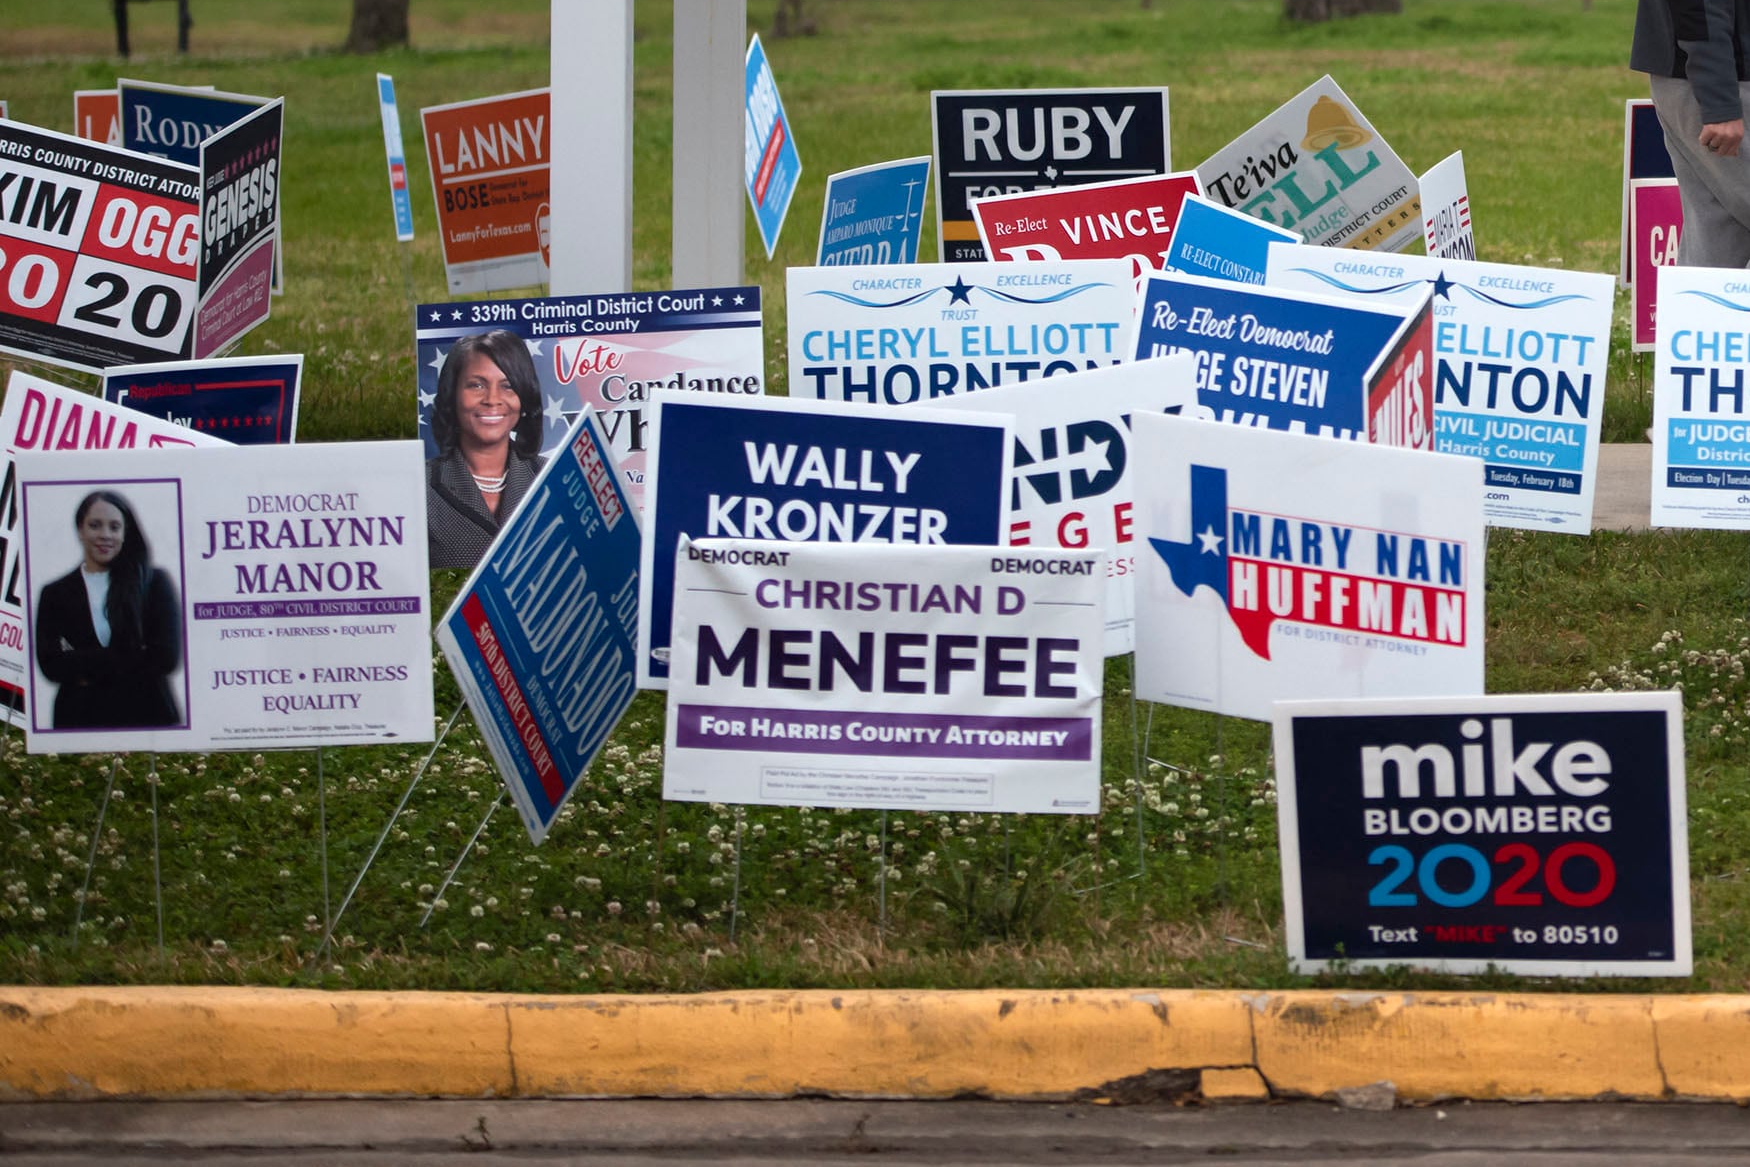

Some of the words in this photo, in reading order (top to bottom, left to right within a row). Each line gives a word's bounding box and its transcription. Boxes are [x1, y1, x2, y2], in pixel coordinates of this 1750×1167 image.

[434, 114, 544, 175] LANNY
[961, 105, 1136, 163] RUBY
[205, 158, 276, 247] GENESIS
[444, 183, 490, 214] BOSE
[1370, 185, 1410, 216] COURT
[98, 198, 200, 267] OGG
[450, 222, 531, 244] LannyForTexas.com
[995, 216, 1048, 237] Re-Elect
[1059, 206, 1171, 245] VINCE
[852, 277, 922, 292] CHARACTER
[996, 273, 1073, 287] EXCELLENCE
[1334, 261, 1405, 279] CHARACTER
[1478, 275, 1555, 294] EXCELLENCE
[74, 271, 182, 338] 20
[471, 302, 516, 324] 339th
[521, 298, 593, 321] Criminal
[596, 294, 653, 318] District
[657, 293, 705, 314] Court
[940, 308, 979, 322] TRUST
[532, 319, 578, 336] Harris
[580, 317, 641, 334] County
[802, 327, 950, 362] CHERYL
[961, 322, 1120, 357] ELLIOTT
[1151, 299, 1236, 341] Re-Elect
[1239, 314, 1334, 356] Democrat
[1436, 321, 1595, 367] ELLIOTT
[553, 338, 625, 385] Vote
[129, 381, 192, 401] Republican
[1230, 354, 1329, 409] STEVEN
[1483, 420, 1580, 447] JUDICIAL
[743, 439, 923, 494] WALLY
[1438, 439, 1490, 457] Harris
[1495, 444, 1556, 465] County
[573, 430, 623, 532] RE-ELECT
[1490, 469, 1521, 486] Tuesday,
[1522, 473, 1554, 490] February
[1674, 472, 1704, 484] Election
[1706, 473, 1721, 486] Day
[247, 492, 359, 514] DEMOCRAT
[562, 468, 600, 540] JUDGE
[706, 493, 949, 545] KRONZER
[202, 515, 406, 560] JERALYNN
[1231, 511, 1352, 570] MARY
[1376, 532, 1462, 586] NAN
[689, 546, 791, 568] DEMOCRAT
[991, 557, 1096, 576] DEMOCRAT
[235, 561, 382, 595] MANOR
[215, 603, 256, 619] JUDGE,
[286, 601, 317, 614] CIVIL
[319, 600, 374, 614] DISTRICT
[375, 599, 416, 612] COURT
[755, 578, 982, 615] CHRISTIAN
[997, 586, 1027, 616] D
[1231, 560, 1466, 645] HUFFMAN
[220, 627, 265, 641] JUSTICE
[276, 625, 330, 638] FAIRNESS
[341, 623, 397, 636] EQUALITY
[492, 486, 634, 757] MALDONADO
[1277, 624, 1300, 637] FOR
[1305, 628, 1360, 646] DISTRICT
[1365, 638, 1428, 657] ATTORNEY
[211, 669, 293, 690] JUSTICE
[312, 665, 408, 684] FAIRNESS
[695, 625, 1081, 700] MENEFEE
[263, 693, 362, 715] EQUALITY
[1360, 718, 1612, 799] mike
[1363, 805, 1612, 835] BLOOMBERG
[1368, 841, 1617, 908] 2020
[1368, 925, 1418, 943] Text
[1424, 925, 1507, 944] "MIKE"
[1513, 926, 1538, 944] to
[1543, 925, 1619, 944] 80510
